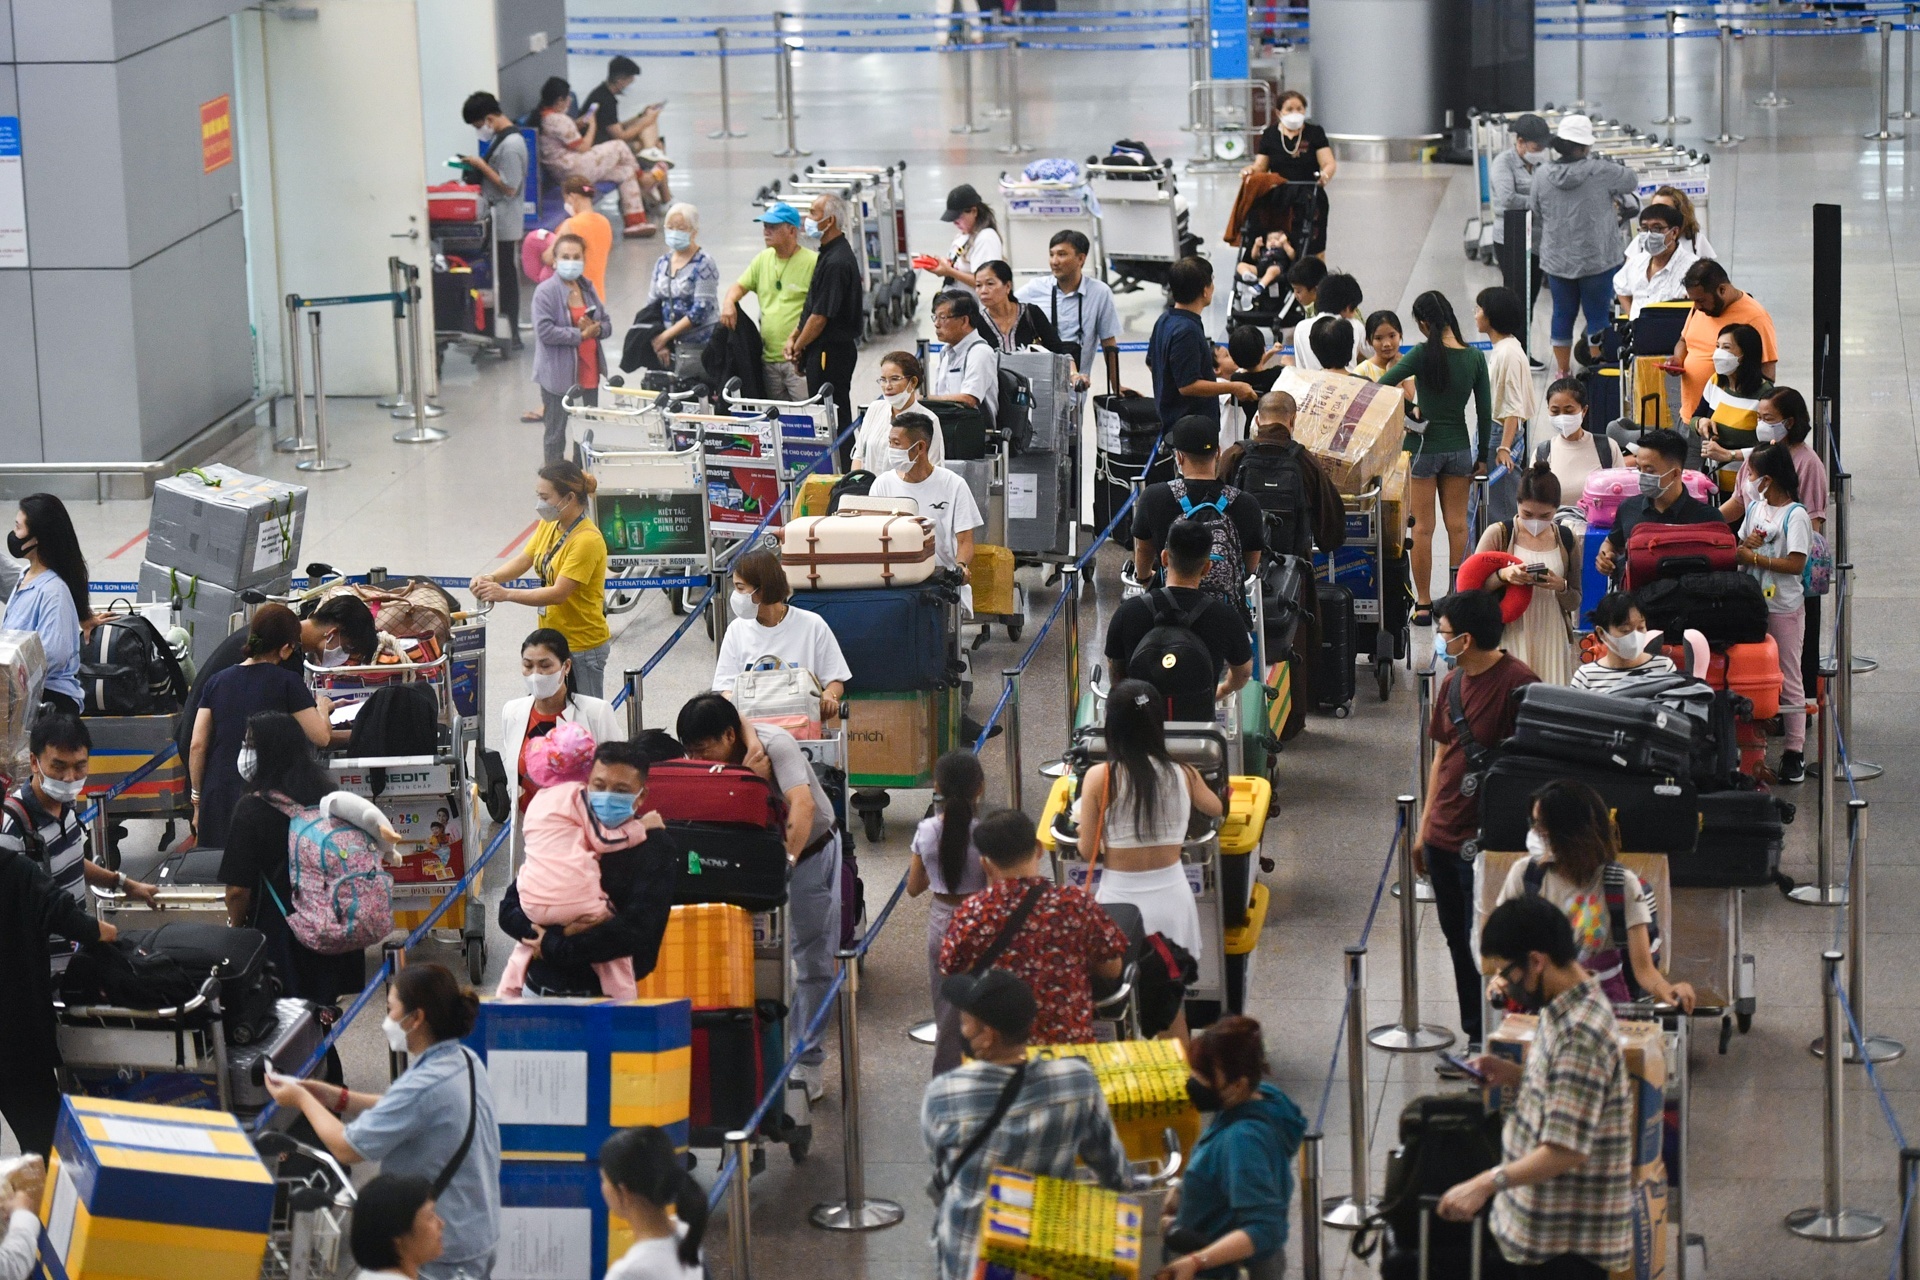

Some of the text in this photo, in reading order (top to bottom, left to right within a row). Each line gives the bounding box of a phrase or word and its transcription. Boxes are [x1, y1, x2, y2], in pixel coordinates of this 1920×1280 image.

[658, 507, 686, 516] KIỆT TÁC
[674, 517, 692, 526] PHỤC
[611, 558, 639, 566] BIZMAN
[607, 578, 691, 587] INTERNATIONAL AIRPORT
[340, 775, 362, 784] FE
[399, 813, 420, 825] 250
